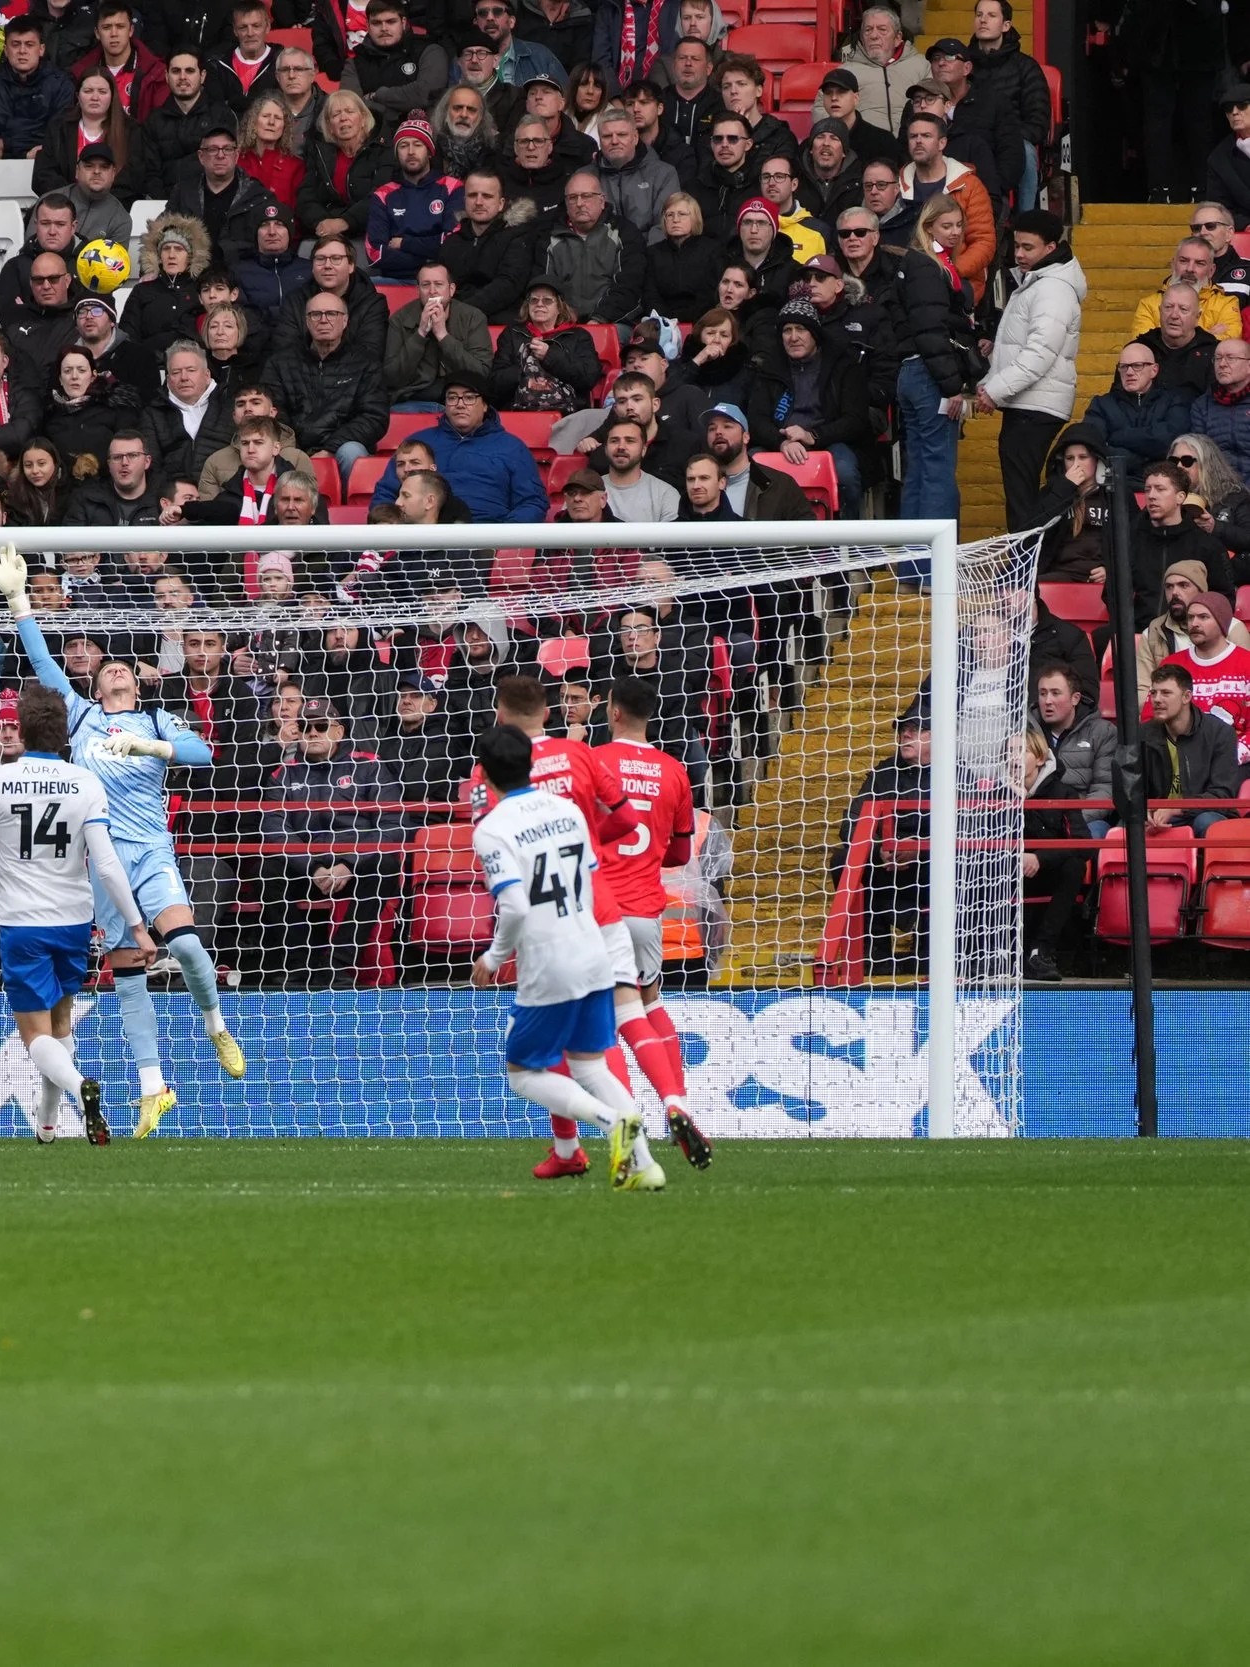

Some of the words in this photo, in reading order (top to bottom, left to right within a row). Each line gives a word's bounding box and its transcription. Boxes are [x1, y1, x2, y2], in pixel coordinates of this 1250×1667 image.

[619, 765, 662, 778] GREENWICH
[2, 781, 79, 795] MATTHEWS
[621, 778, 661, 797] JONES
[11, 803, 71, 860] 14
[514, 817, 579, 848] MINHYEOK
[529, 842, 585, 918] 47
